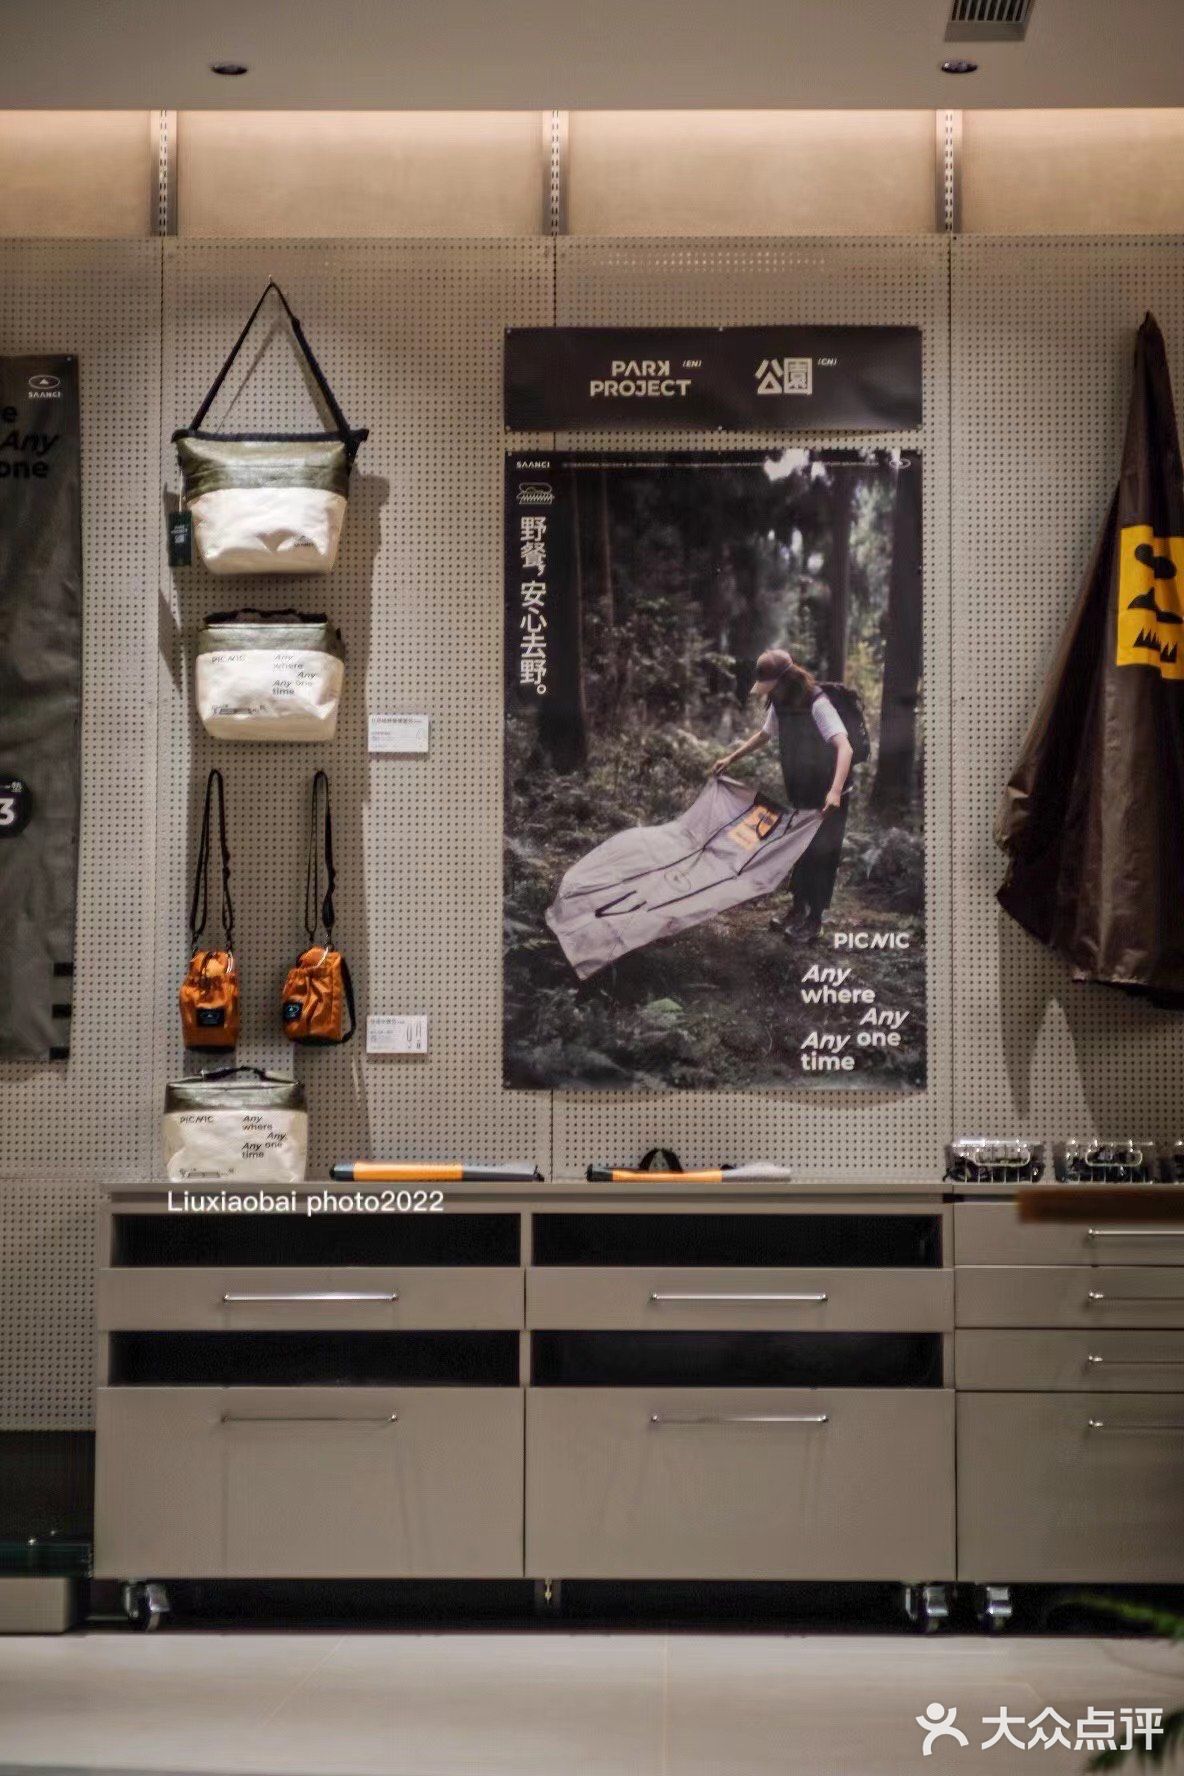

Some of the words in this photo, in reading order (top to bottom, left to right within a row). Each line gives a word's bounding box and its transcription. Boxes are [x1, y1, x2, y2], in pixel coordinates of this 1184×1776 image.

[610, 359, 671, 377] PARK
[754, 356, 813, 395] 公園
[589, 379, 692, 397] PROJECT
[833, 932, 911, 949] PICNIC
[801, 964, 852, 987] Any
[801, 985, 876, 1004] where
[859, 1007, 911, 1029] Any
[800, 1031, 851, 1053] Any
[856, 1032, 902, 1047] one
[801, 1051, 855, 1071] time
[242, 1115, 263, 1123] Any
[266, 1132, 288, 1141] Any
[241, 1142, 262, 1151] Any
[241, 1151, 265, 1160] time
